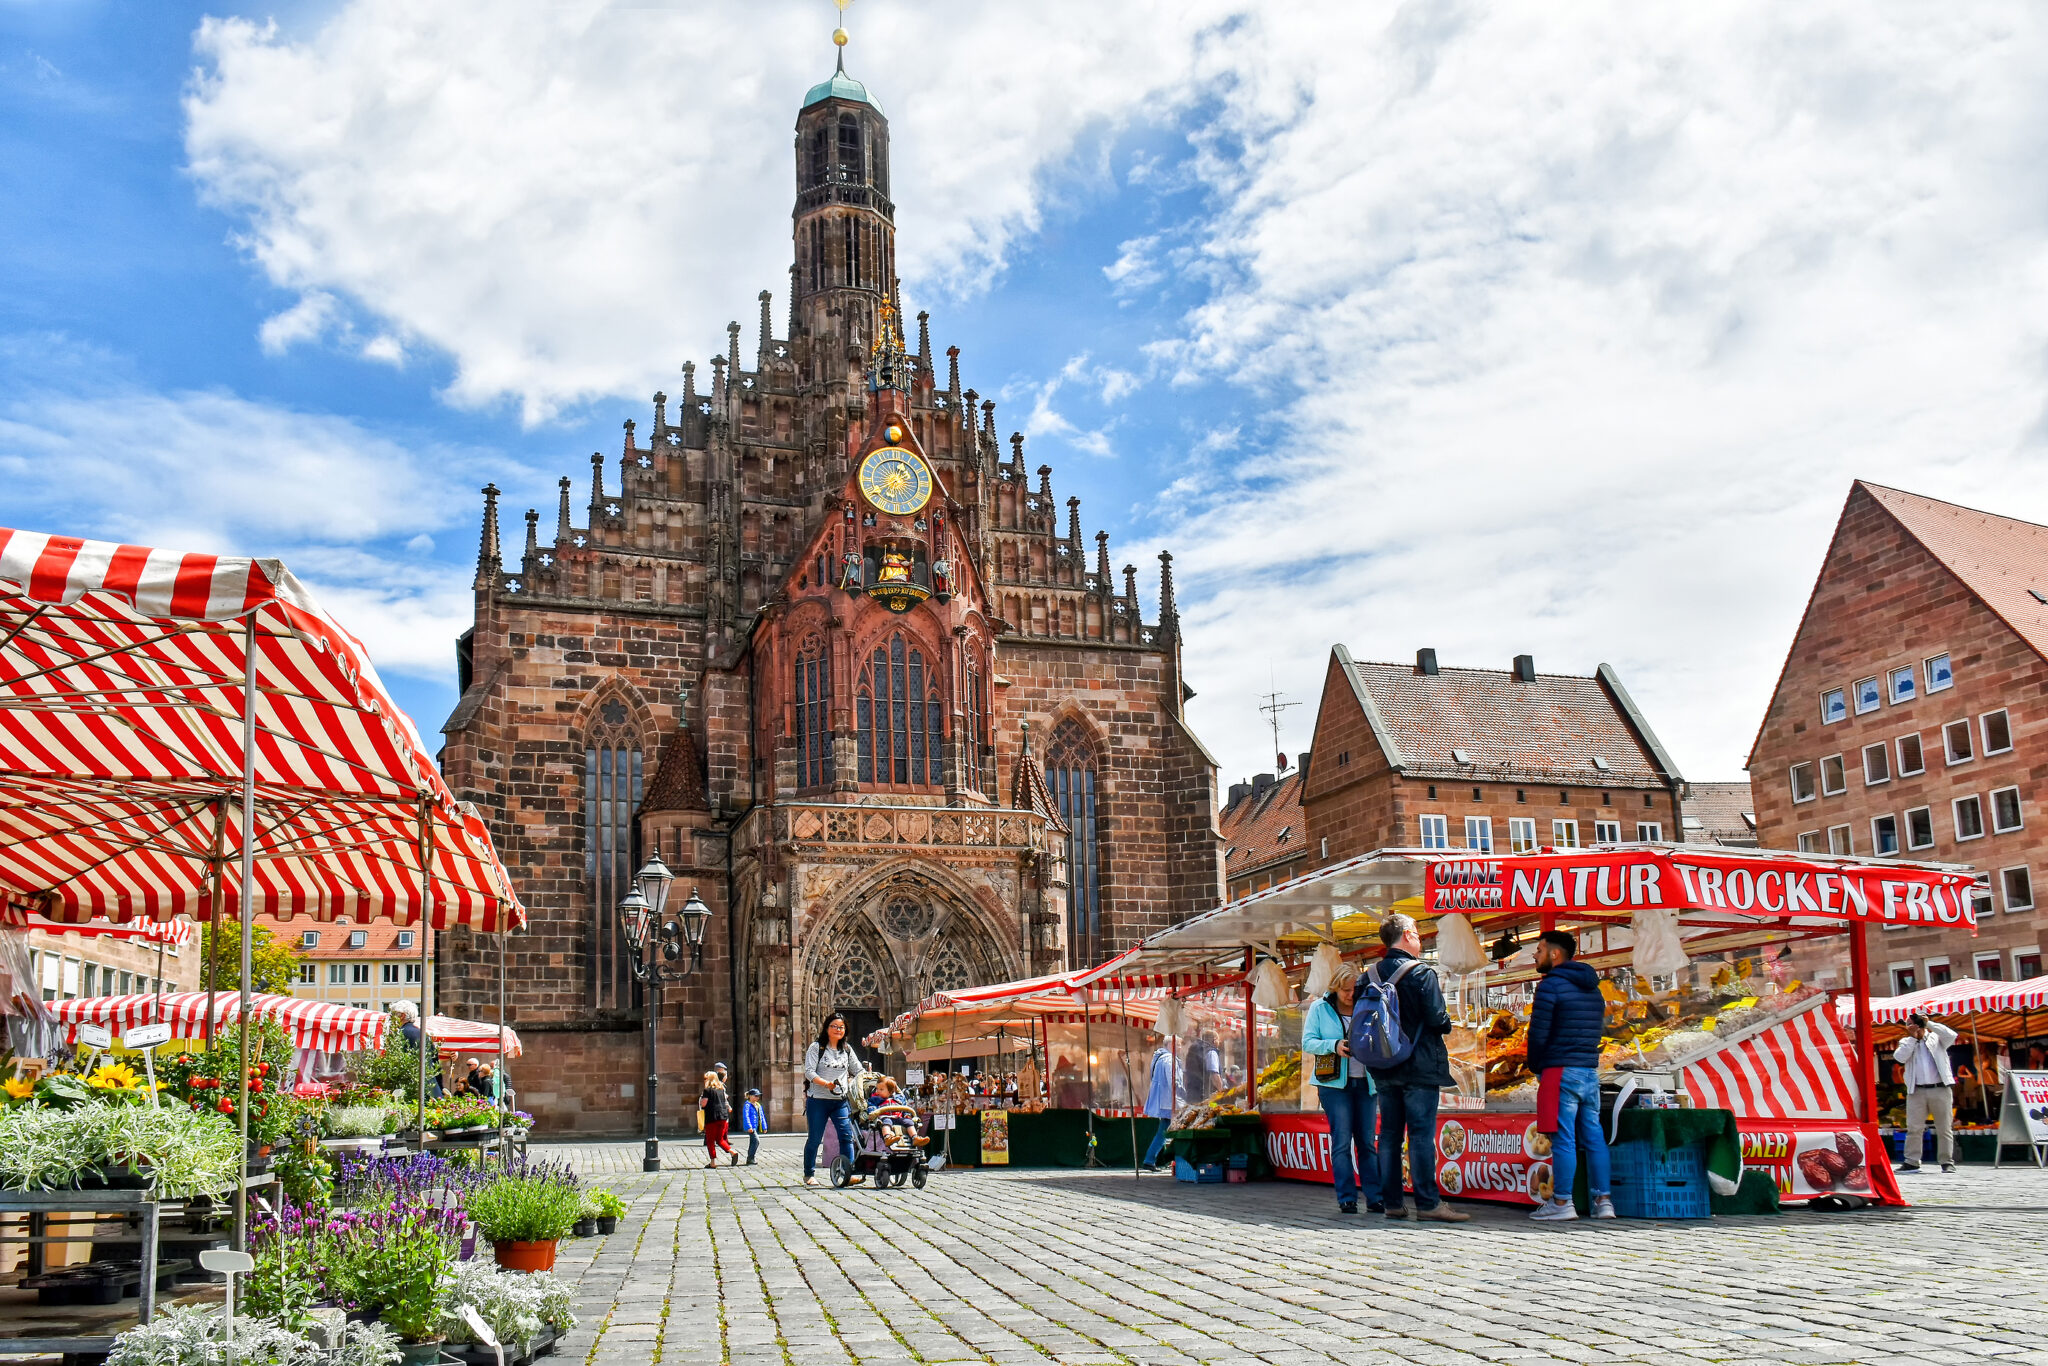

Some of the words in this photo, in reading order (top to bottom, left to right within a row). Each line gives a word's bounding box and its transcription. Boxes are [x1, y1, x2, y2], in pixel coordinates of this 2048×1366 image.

[1433, 861, 1504, 886] OHNE
[1433, 887, 1503, 910] ZUCKER
[1510, 863, 1664, 908] NATUR
[1672, 863, 1869, 917] TROCKEN
[1264, 1131, 1318, 1171] OCKEN
[1467, 1129, 1522, 1154] Verschiedene
[1464, 1156, 1527, 1193] NÜSSE
